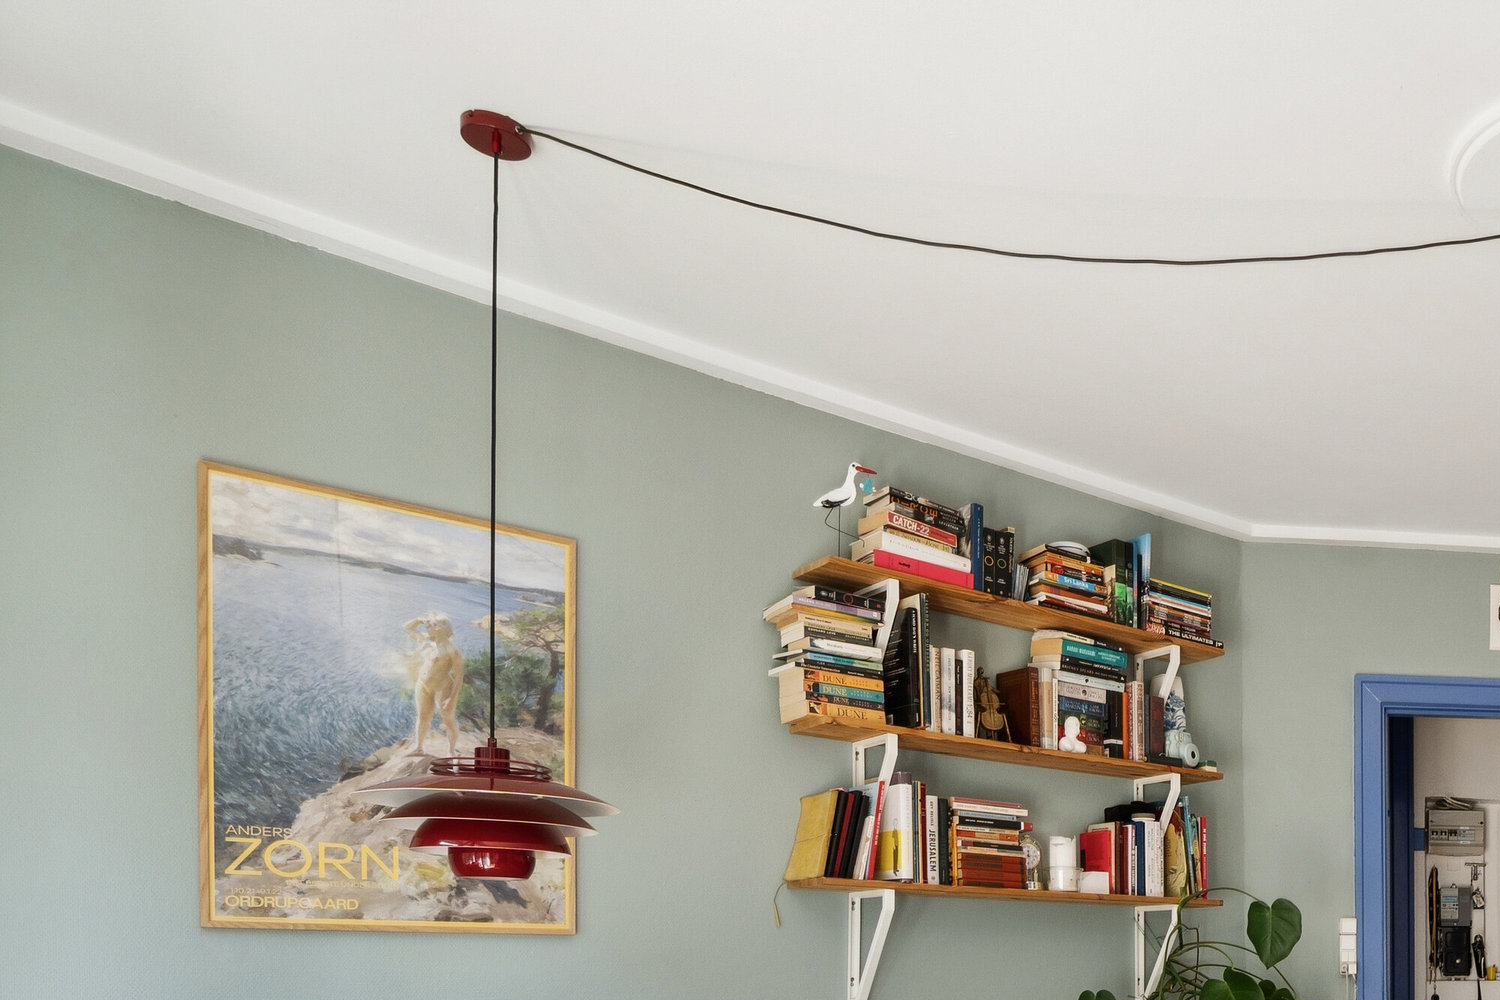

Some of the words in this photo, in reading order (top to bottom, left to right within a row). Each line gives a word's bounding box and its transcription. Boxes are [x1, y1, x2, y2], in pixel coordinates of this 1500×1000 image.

[892, 515, 930, 536] CATCH-22
[1072, 578, 1089, 588] Lanka
[1168, 629, 1180, 637] THE
[1181, 631, 1214, 645] ULTIMATES
[822, 675, 847, 685] DUNE
[822, 686, 848, 696] DUNE
[836, 708, 868, 720] DUNE
[225, 824, 293, 838] ANDERS
[224, 837, 399, 881] ZORN
[224, 895, 359, 910] ORDRUPGAARD
